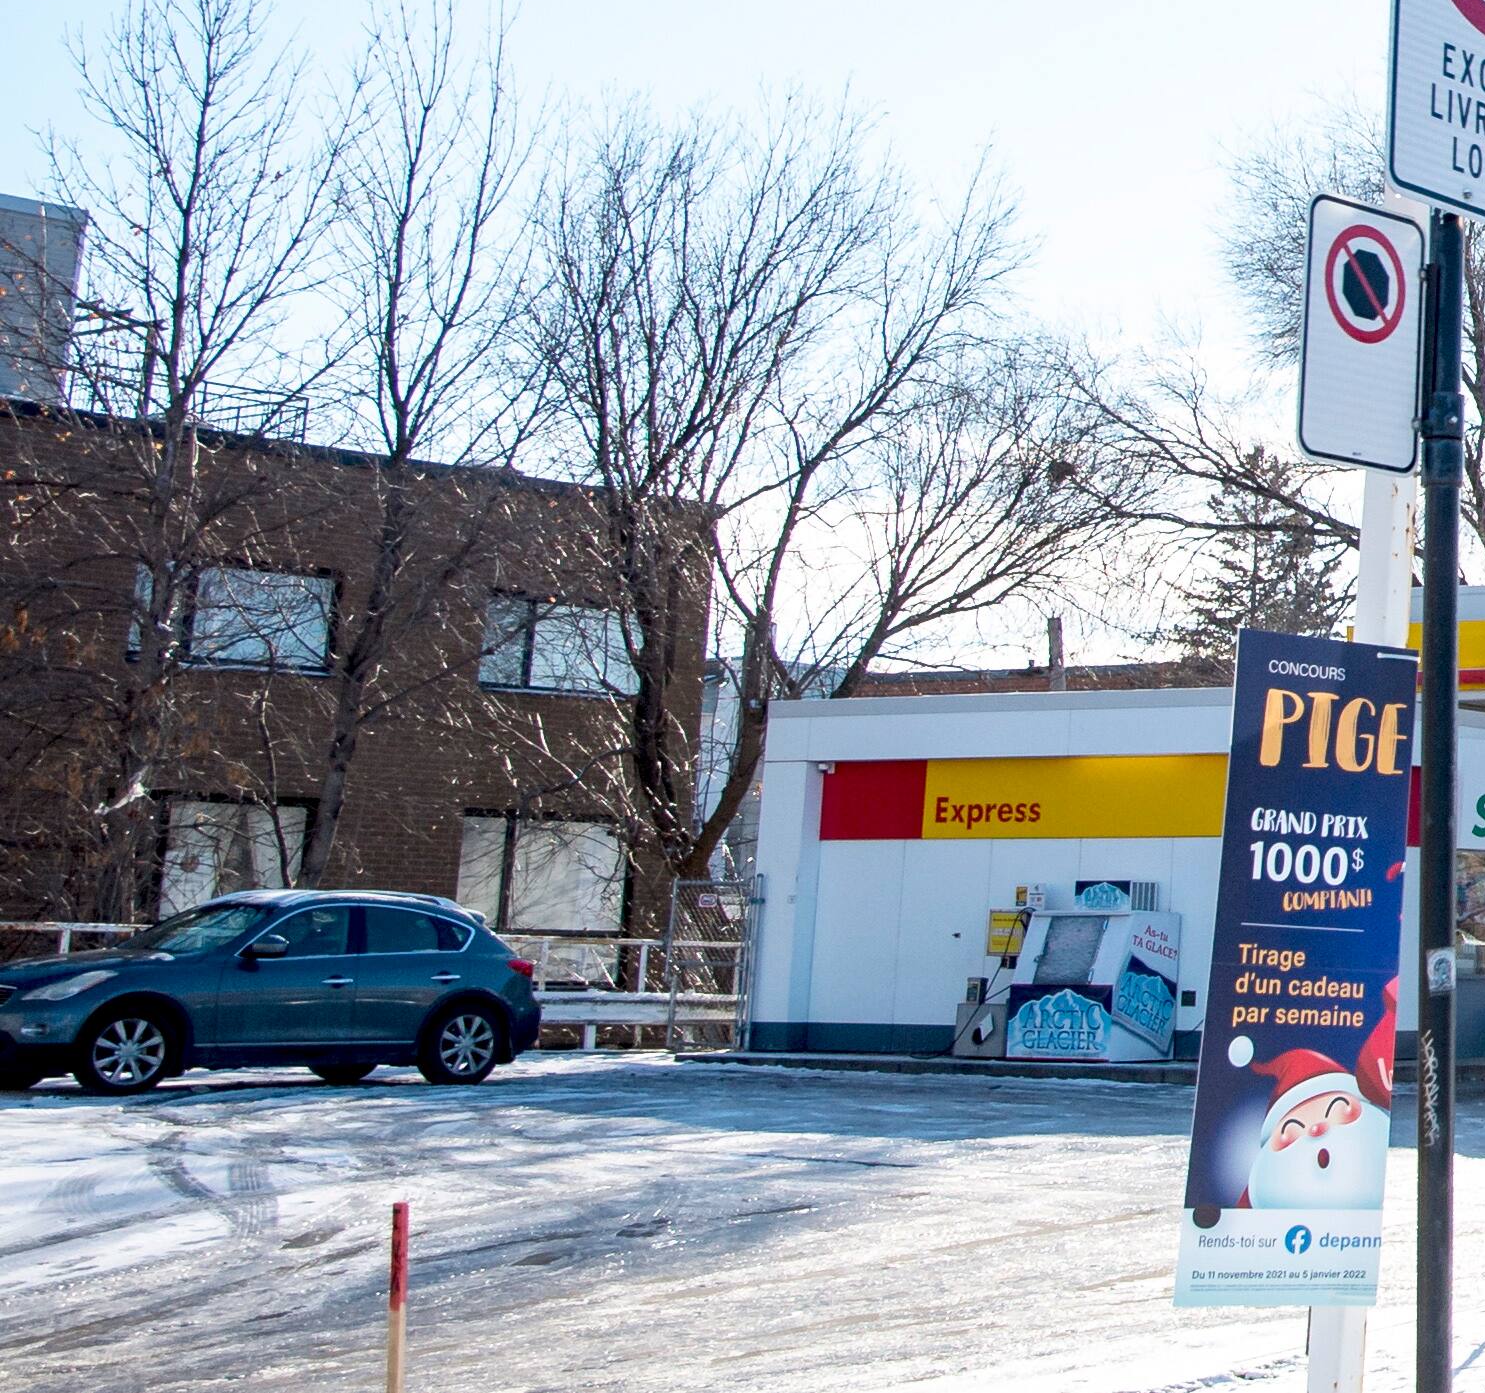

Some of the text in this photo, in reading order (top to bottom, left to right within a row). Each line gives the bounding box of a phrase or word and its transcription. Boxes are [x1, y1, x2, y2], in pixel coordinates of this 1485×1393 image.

[1268, 659, 1346, 681] CONCOURS
[1260, 688, 1408, 775] PIGE
[935, 797, 1041, 830] Express
[1251, 807, 1369, 839] GRAND PRIX
[1283, 888, 1373, 911] COMPTANT!
[1132, 935, 1145, 948] TA
[1238, 943, 1306, 972] Tirage
[1119, 973, 1174, 1022] ARCTIC
[1235, 972, 1365, 999] d'un cadeau
[1022, 1003, 1103, 1030] ARCTIC
[1117, 994, 1166, 1036] GLACIER
[1232, 1004, 1364, 1028] par semaine
[1022, 1030, 1099, 1051] GLACIER
[1198, 1234, 1255, 1248] Rends-toi
[1258, 1237, 1278, 1248] sur
[1191, 1269, 1367, 1280] Du 11 novembre 2021 au 5 janvier 2022
